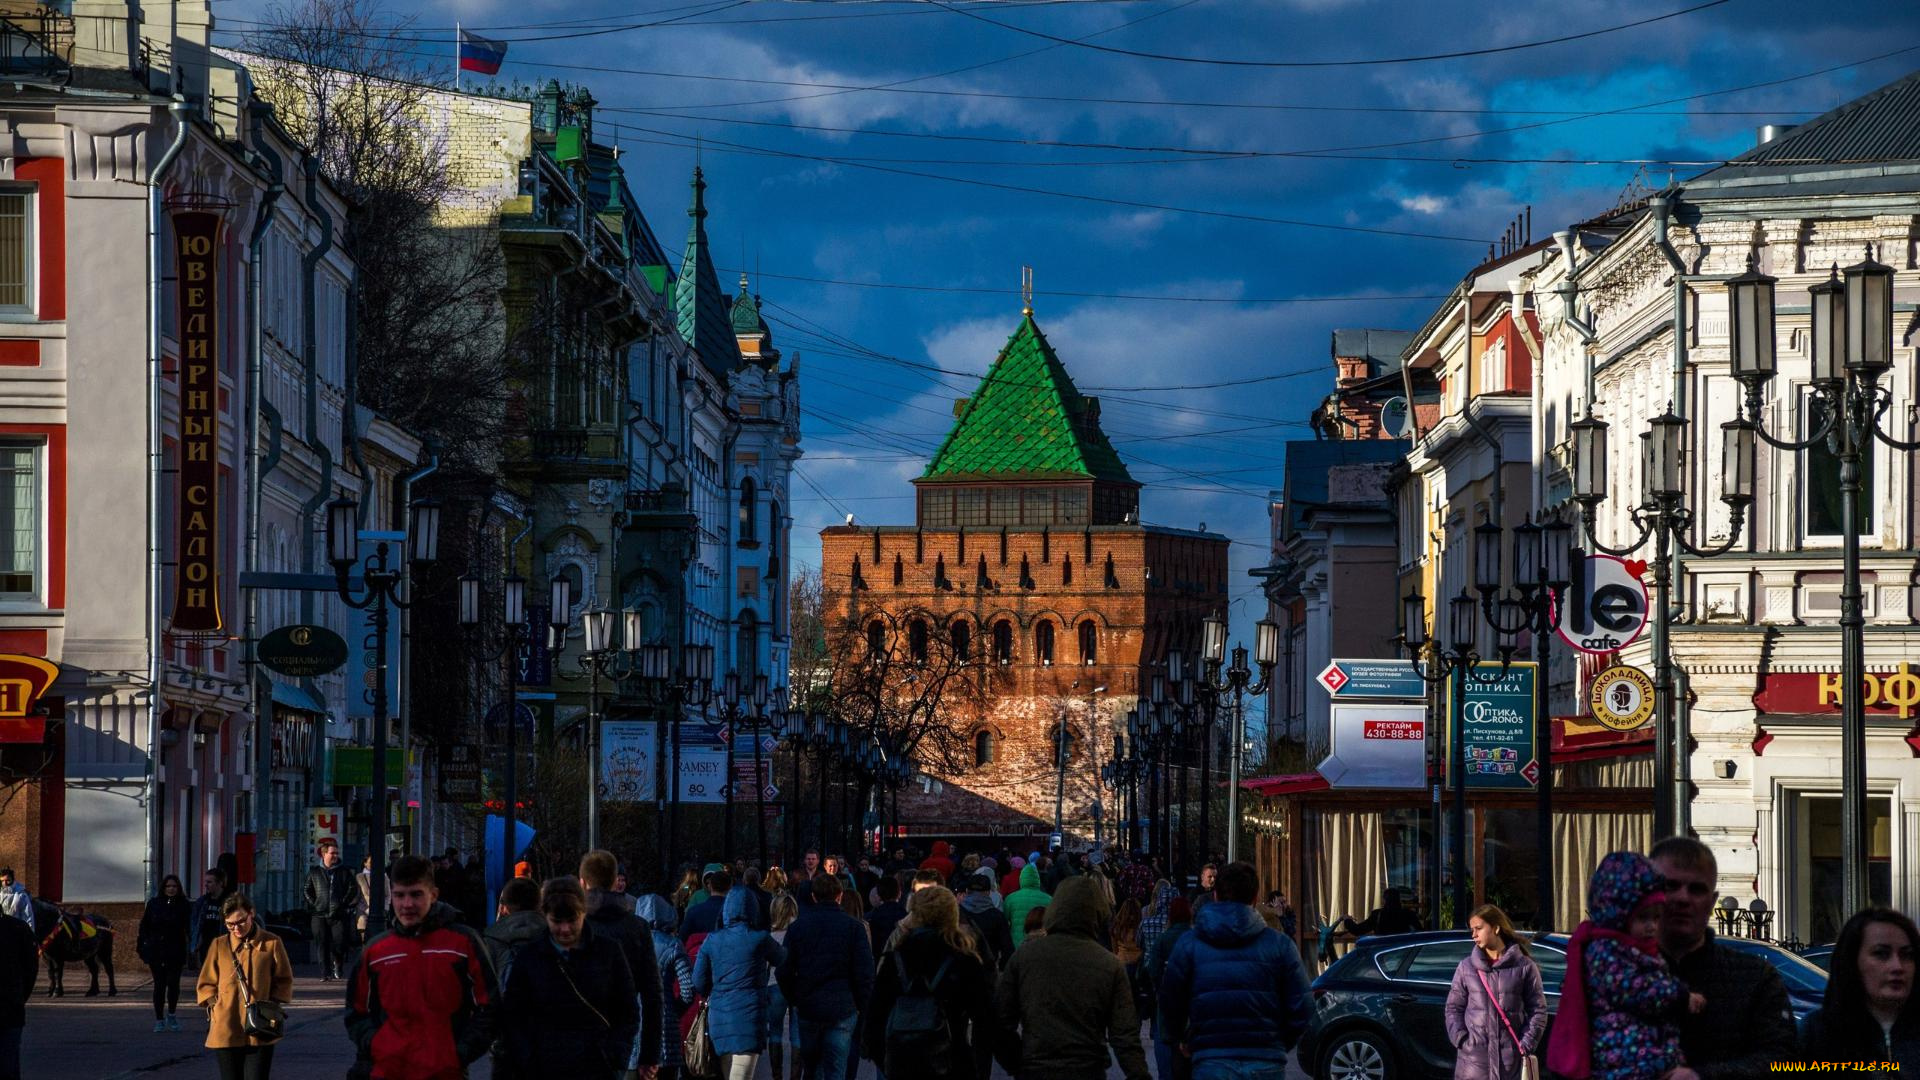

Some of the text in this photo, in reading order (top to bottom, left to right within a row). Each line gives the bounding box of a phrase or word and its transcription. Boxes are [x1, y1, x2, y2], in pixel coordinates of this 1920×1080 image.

[185, 485, 208, 608] САЛОН
[1581, 634, 1621, 650] cafe
[1464, 683, 1521, 692] ОПТИКА
[1593, 669, 1653, 704] ШОКОЛАДНИЦА
[1376, 721, 1412, 729] РЕКТАЙМ
[1603, 712, 1643, 728] кофейня
[1366, 729, 1422, 739] 430-88-88
[688, 784, 705, 793] 80
